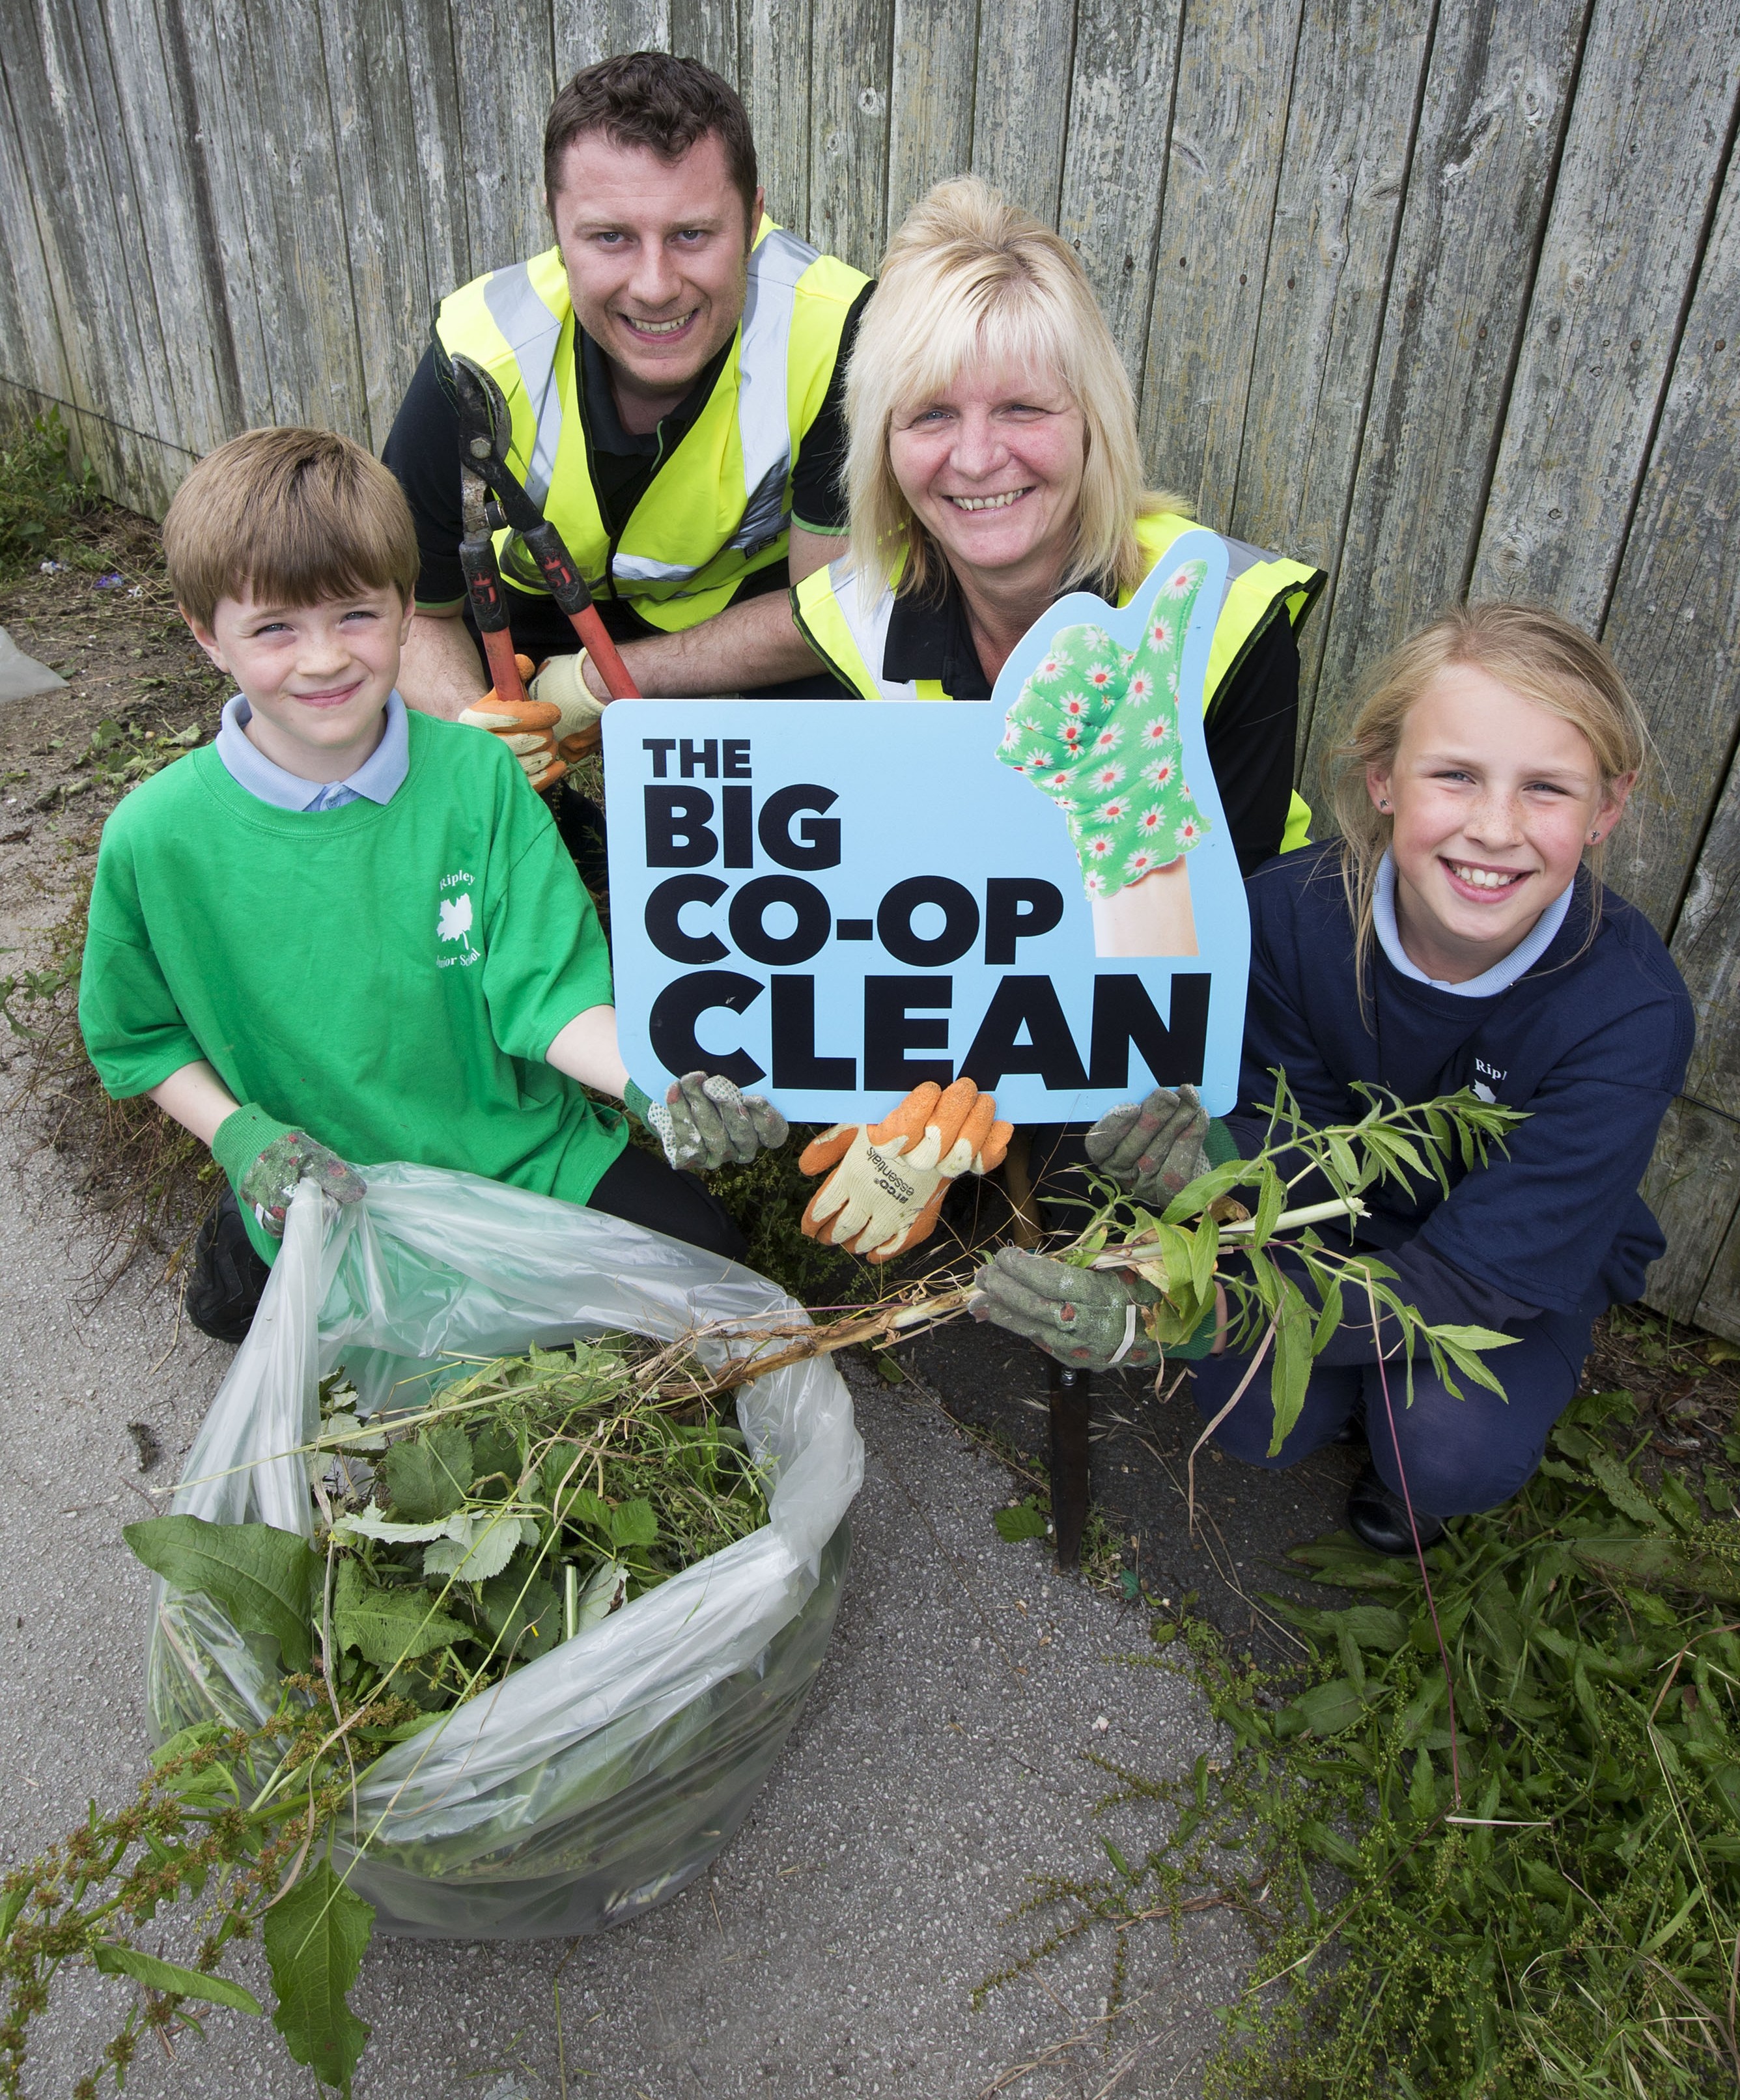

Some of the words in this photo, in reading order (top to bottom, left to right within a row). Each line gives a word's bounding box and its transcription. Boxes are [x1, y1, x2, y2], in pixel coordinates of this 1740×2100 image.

[643, 738, 752, 779] THE
[643, 783, 841, 871] BIG
[439, 869, 476, 891] Ripley
[644, 873, 1064, 967] CO-OP
[648, 970, 1212, 1091] CLEAN
[866, 1147, 914, 1196] essentials
